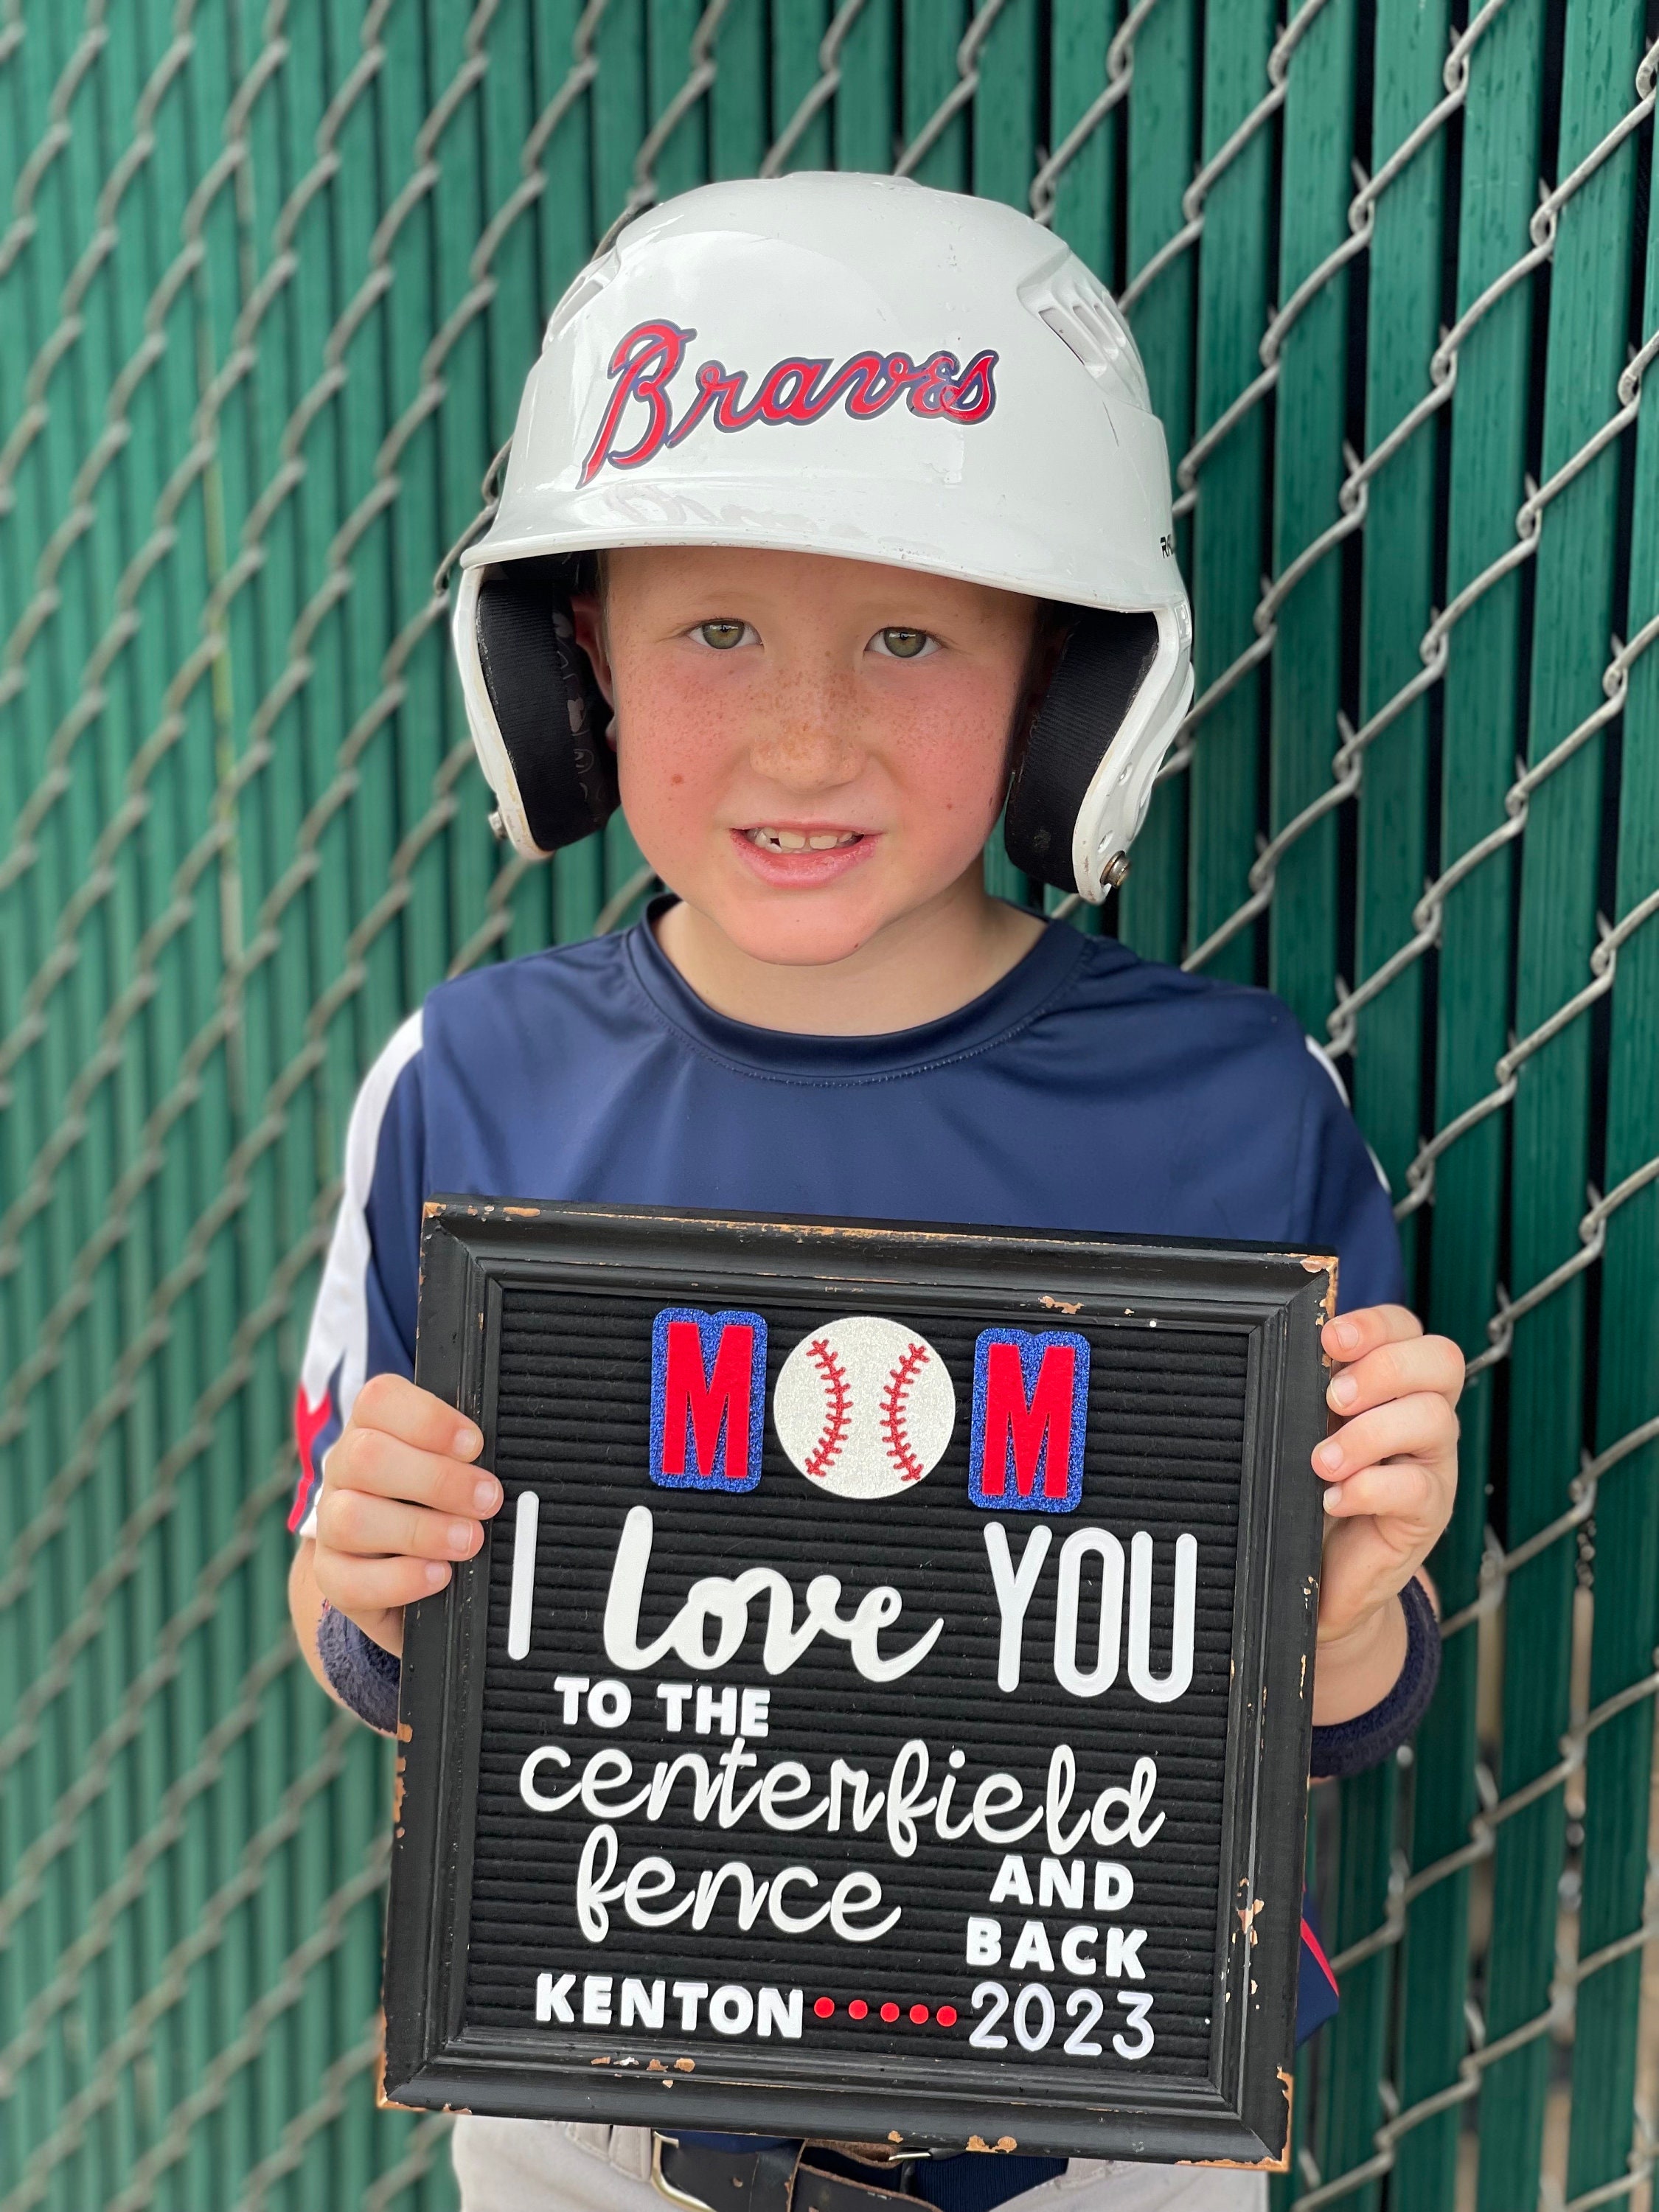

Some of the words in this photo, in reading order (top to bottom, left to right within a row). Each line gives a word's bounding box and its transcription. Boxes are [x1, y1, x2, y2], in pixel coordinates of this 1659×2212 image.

[575, 318, 1000, 490] Braves
[507, 1490, 540, 1660] I
[982, 1520, 1199, 1705] YOU
[552, 1675, 633, 1729] TO
[655, 1682, 771, 1738] THE
[519, 1736, 1166, 1859] centerfield
[575, 1823, 902, 1944] fence
[988, 1853, 1135, 1912] AND
[965, 1915, 1149, 1980] BACK
[535, 1972, 804, 2039] KENTON
[968, 1980, 1155, 2061] 2023
